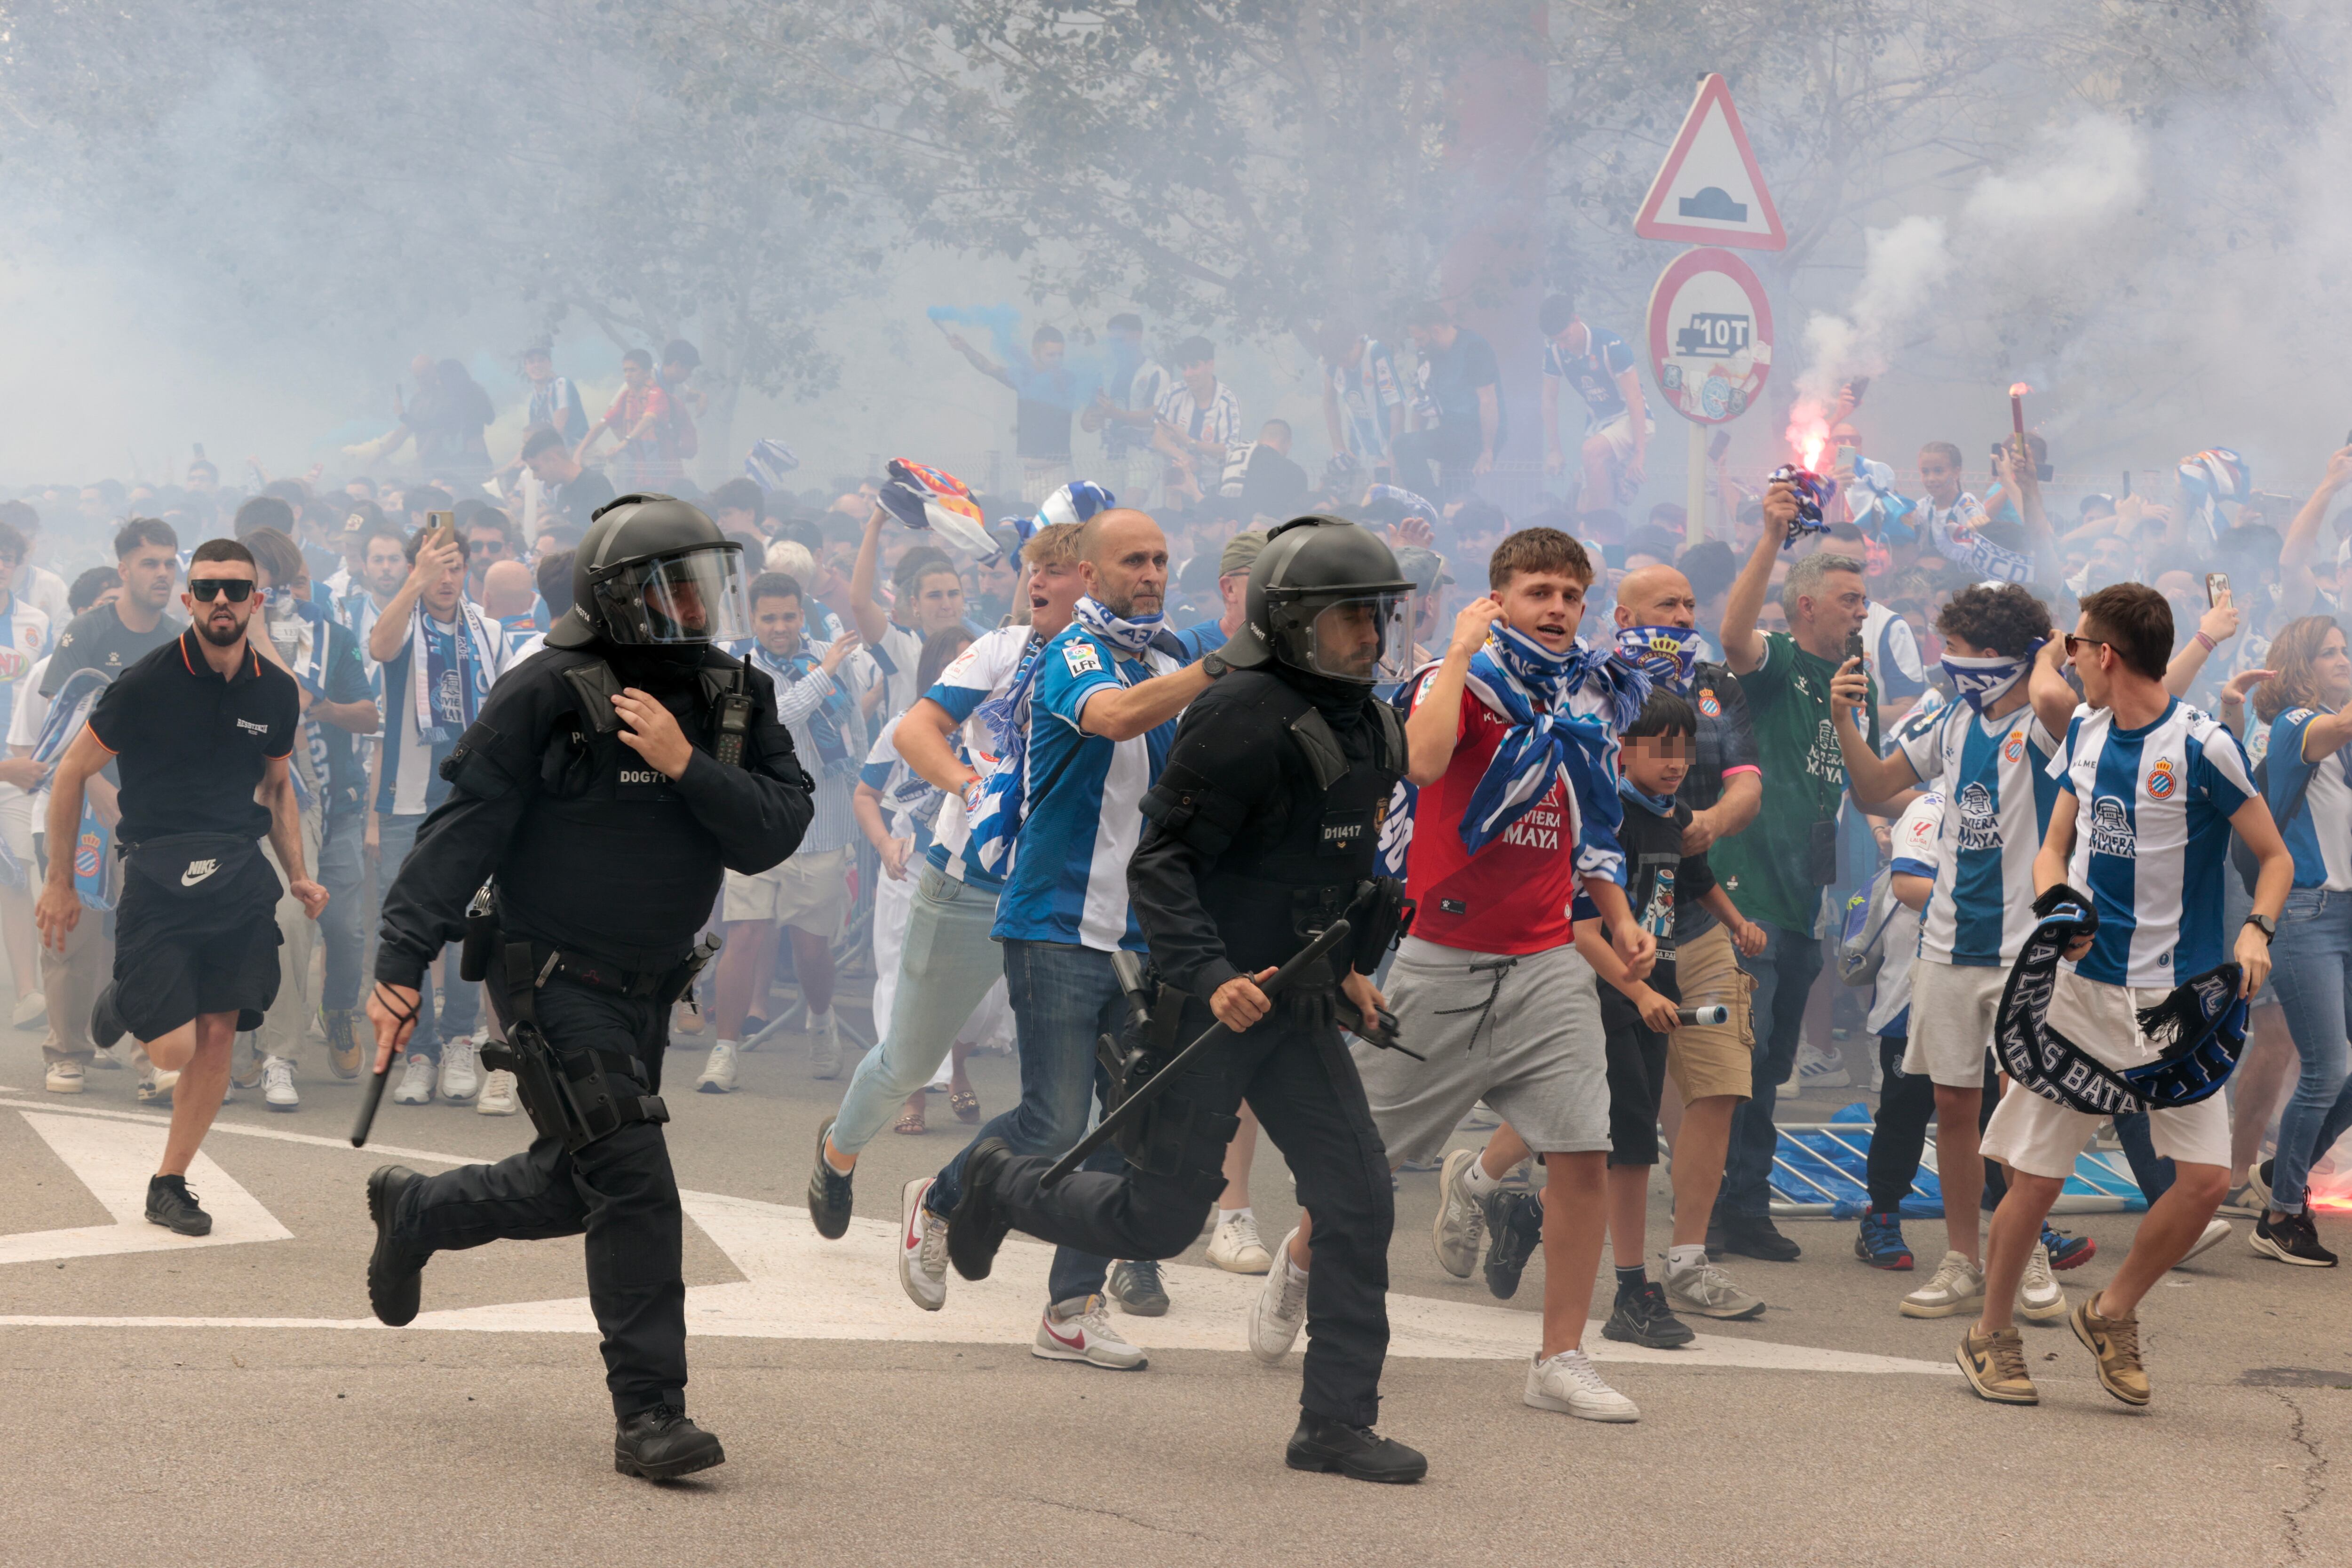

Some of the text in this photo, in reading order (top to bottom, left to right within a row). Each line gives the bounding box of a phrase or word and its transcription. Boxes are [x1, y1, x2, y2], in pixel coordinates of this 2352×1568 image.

[1700, 319, 1748, 346] 10T
[1972, 544, 2029, 584] RCD
[1073, 660, 1097, 674] LFP
[1517, 810, 1561, 828] VIERA
[1502, 824, 1558, 850] MAYA
[1958, 826, 2004, 848] MAYA
[187, 859, 216, 876] NIKE
[2002, 1023, 2078, 1111] MEJO
